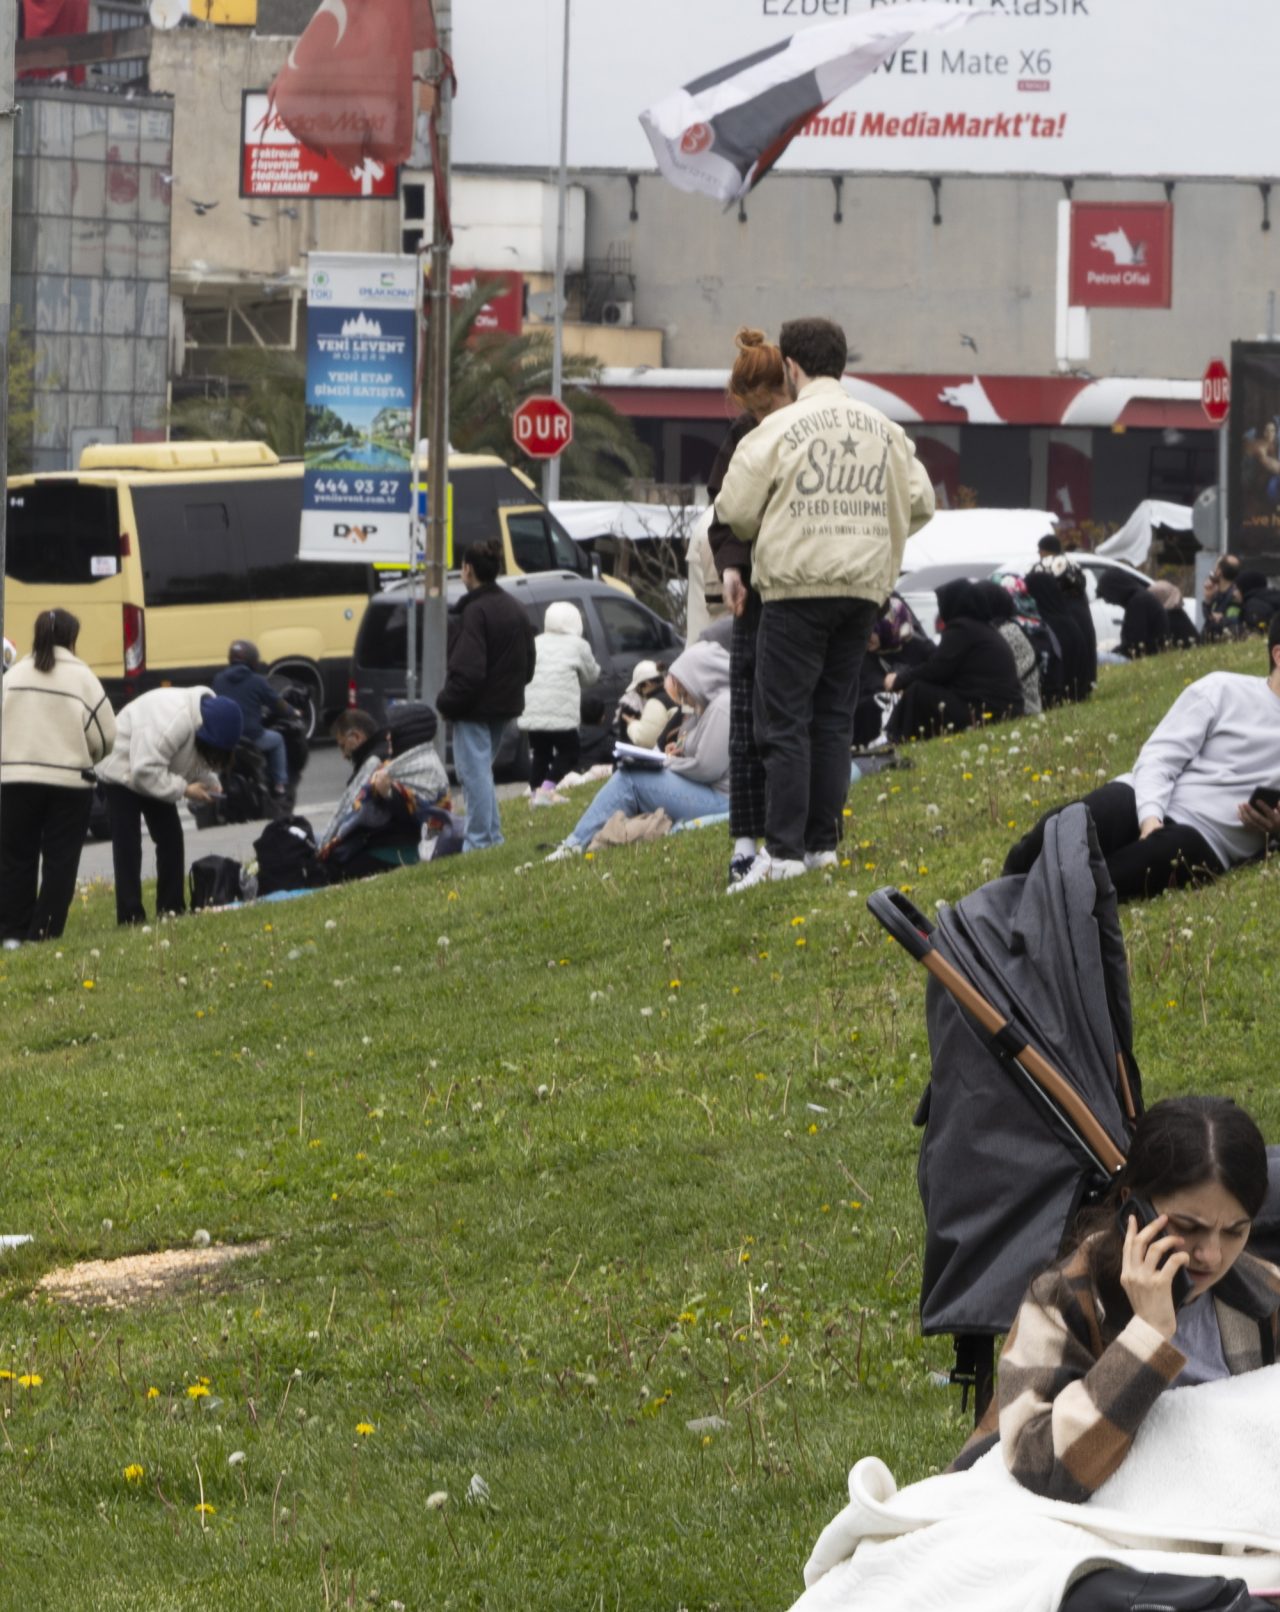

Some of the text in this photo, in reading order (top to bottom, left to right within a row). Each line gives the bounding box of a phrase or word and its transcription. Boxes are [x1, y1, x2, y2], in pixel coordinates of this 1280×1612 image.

[991, 0, 1089, 16] lasik
[941, 51, 1008, 74] Mate
[1019, 50, 1052, 74] X6
[860, 111, 1067, 138] MediaMarkt'ta!
[1087, 271, 1150, 285] Petrol Ofisi
[317, 338, 405, 354] YENİ LEVENT
[360, 372, 393, 383] ETAP
[1204, 378, 1230, 402] DUR
[518, 415, 567, 439] DUR
[784, 408, 842, 450] SERVICE
[314, 478, 399, 495] 444 93 27
[789, 499, 888, 518] SPEED EQUIPME
